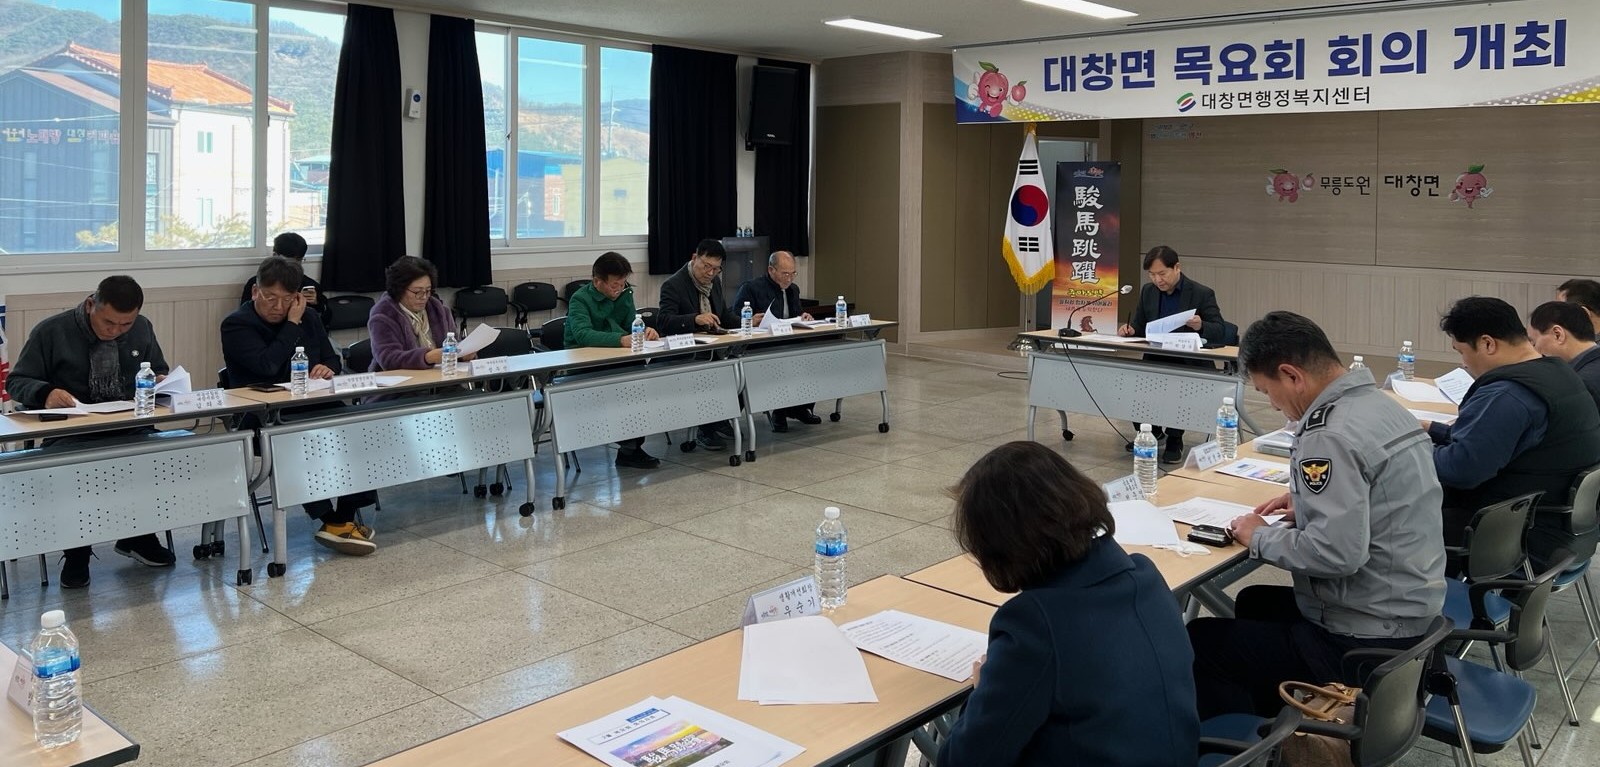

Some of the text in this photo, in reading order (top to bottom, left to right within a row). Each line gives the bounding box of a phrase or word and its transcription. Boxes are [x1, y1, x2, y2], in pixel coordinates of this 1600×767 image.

[1044, 19, 1567, 92] 대창면 목요회 회의 개최
[1201, 86, 1371, 110] 대창면행정복지센터
[1320, 174, 1440, 197] 무릉도원 대창면
[1070, 185, 1104, 284] 駿馬跳躍
